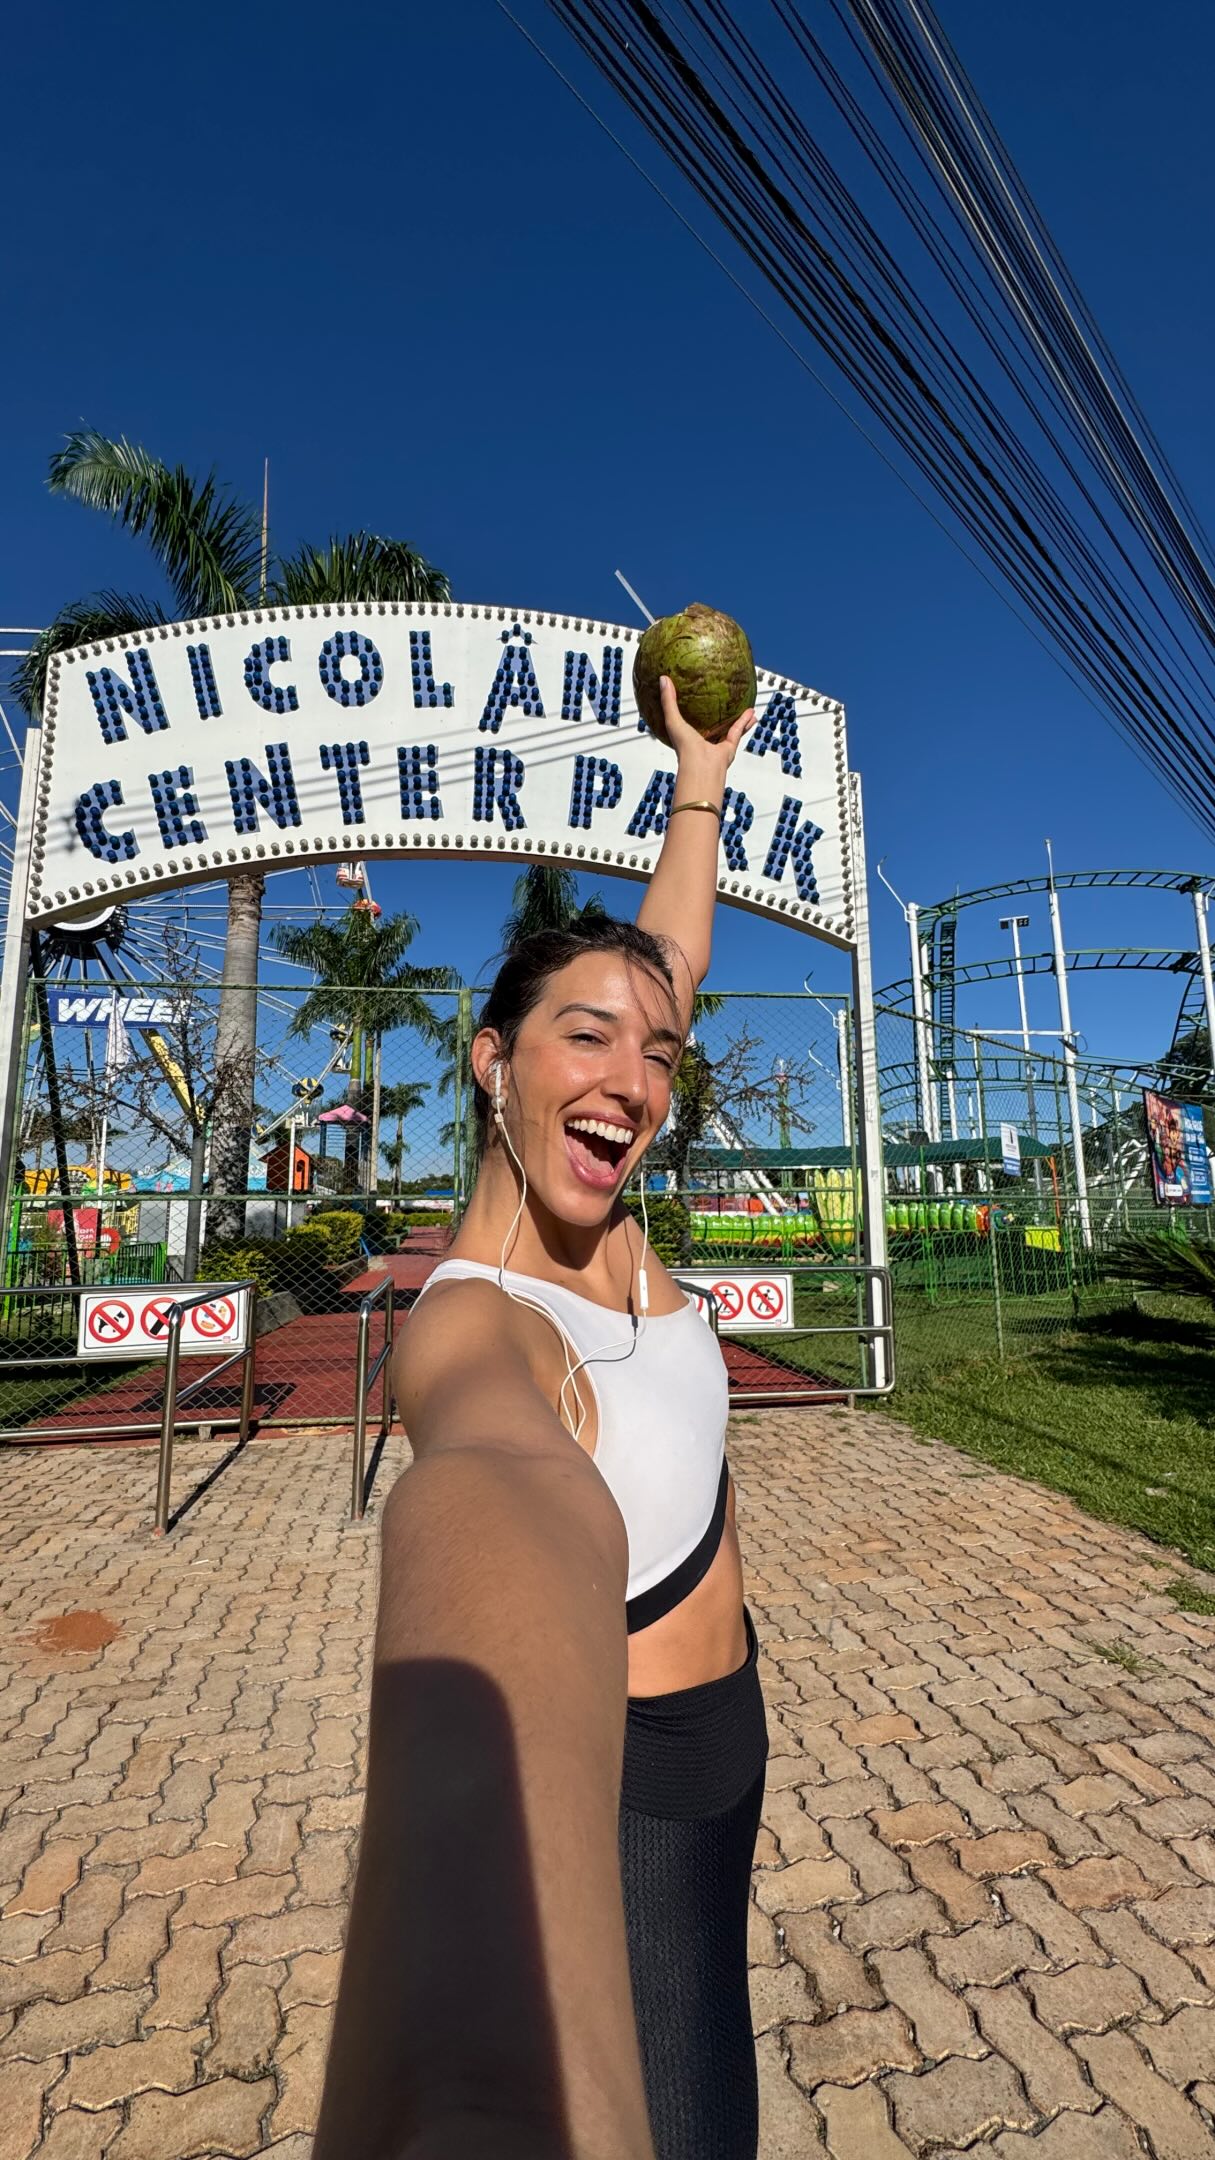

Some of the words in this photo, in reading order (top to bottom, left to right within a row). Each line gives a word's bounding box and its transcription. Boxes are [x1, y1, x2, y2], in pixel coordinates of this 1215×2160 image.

[86, 624, 803, 780] NICOLÂNA
[76, 741, 528, 863] CENTER
[567, 754, 825, 906] PARK
